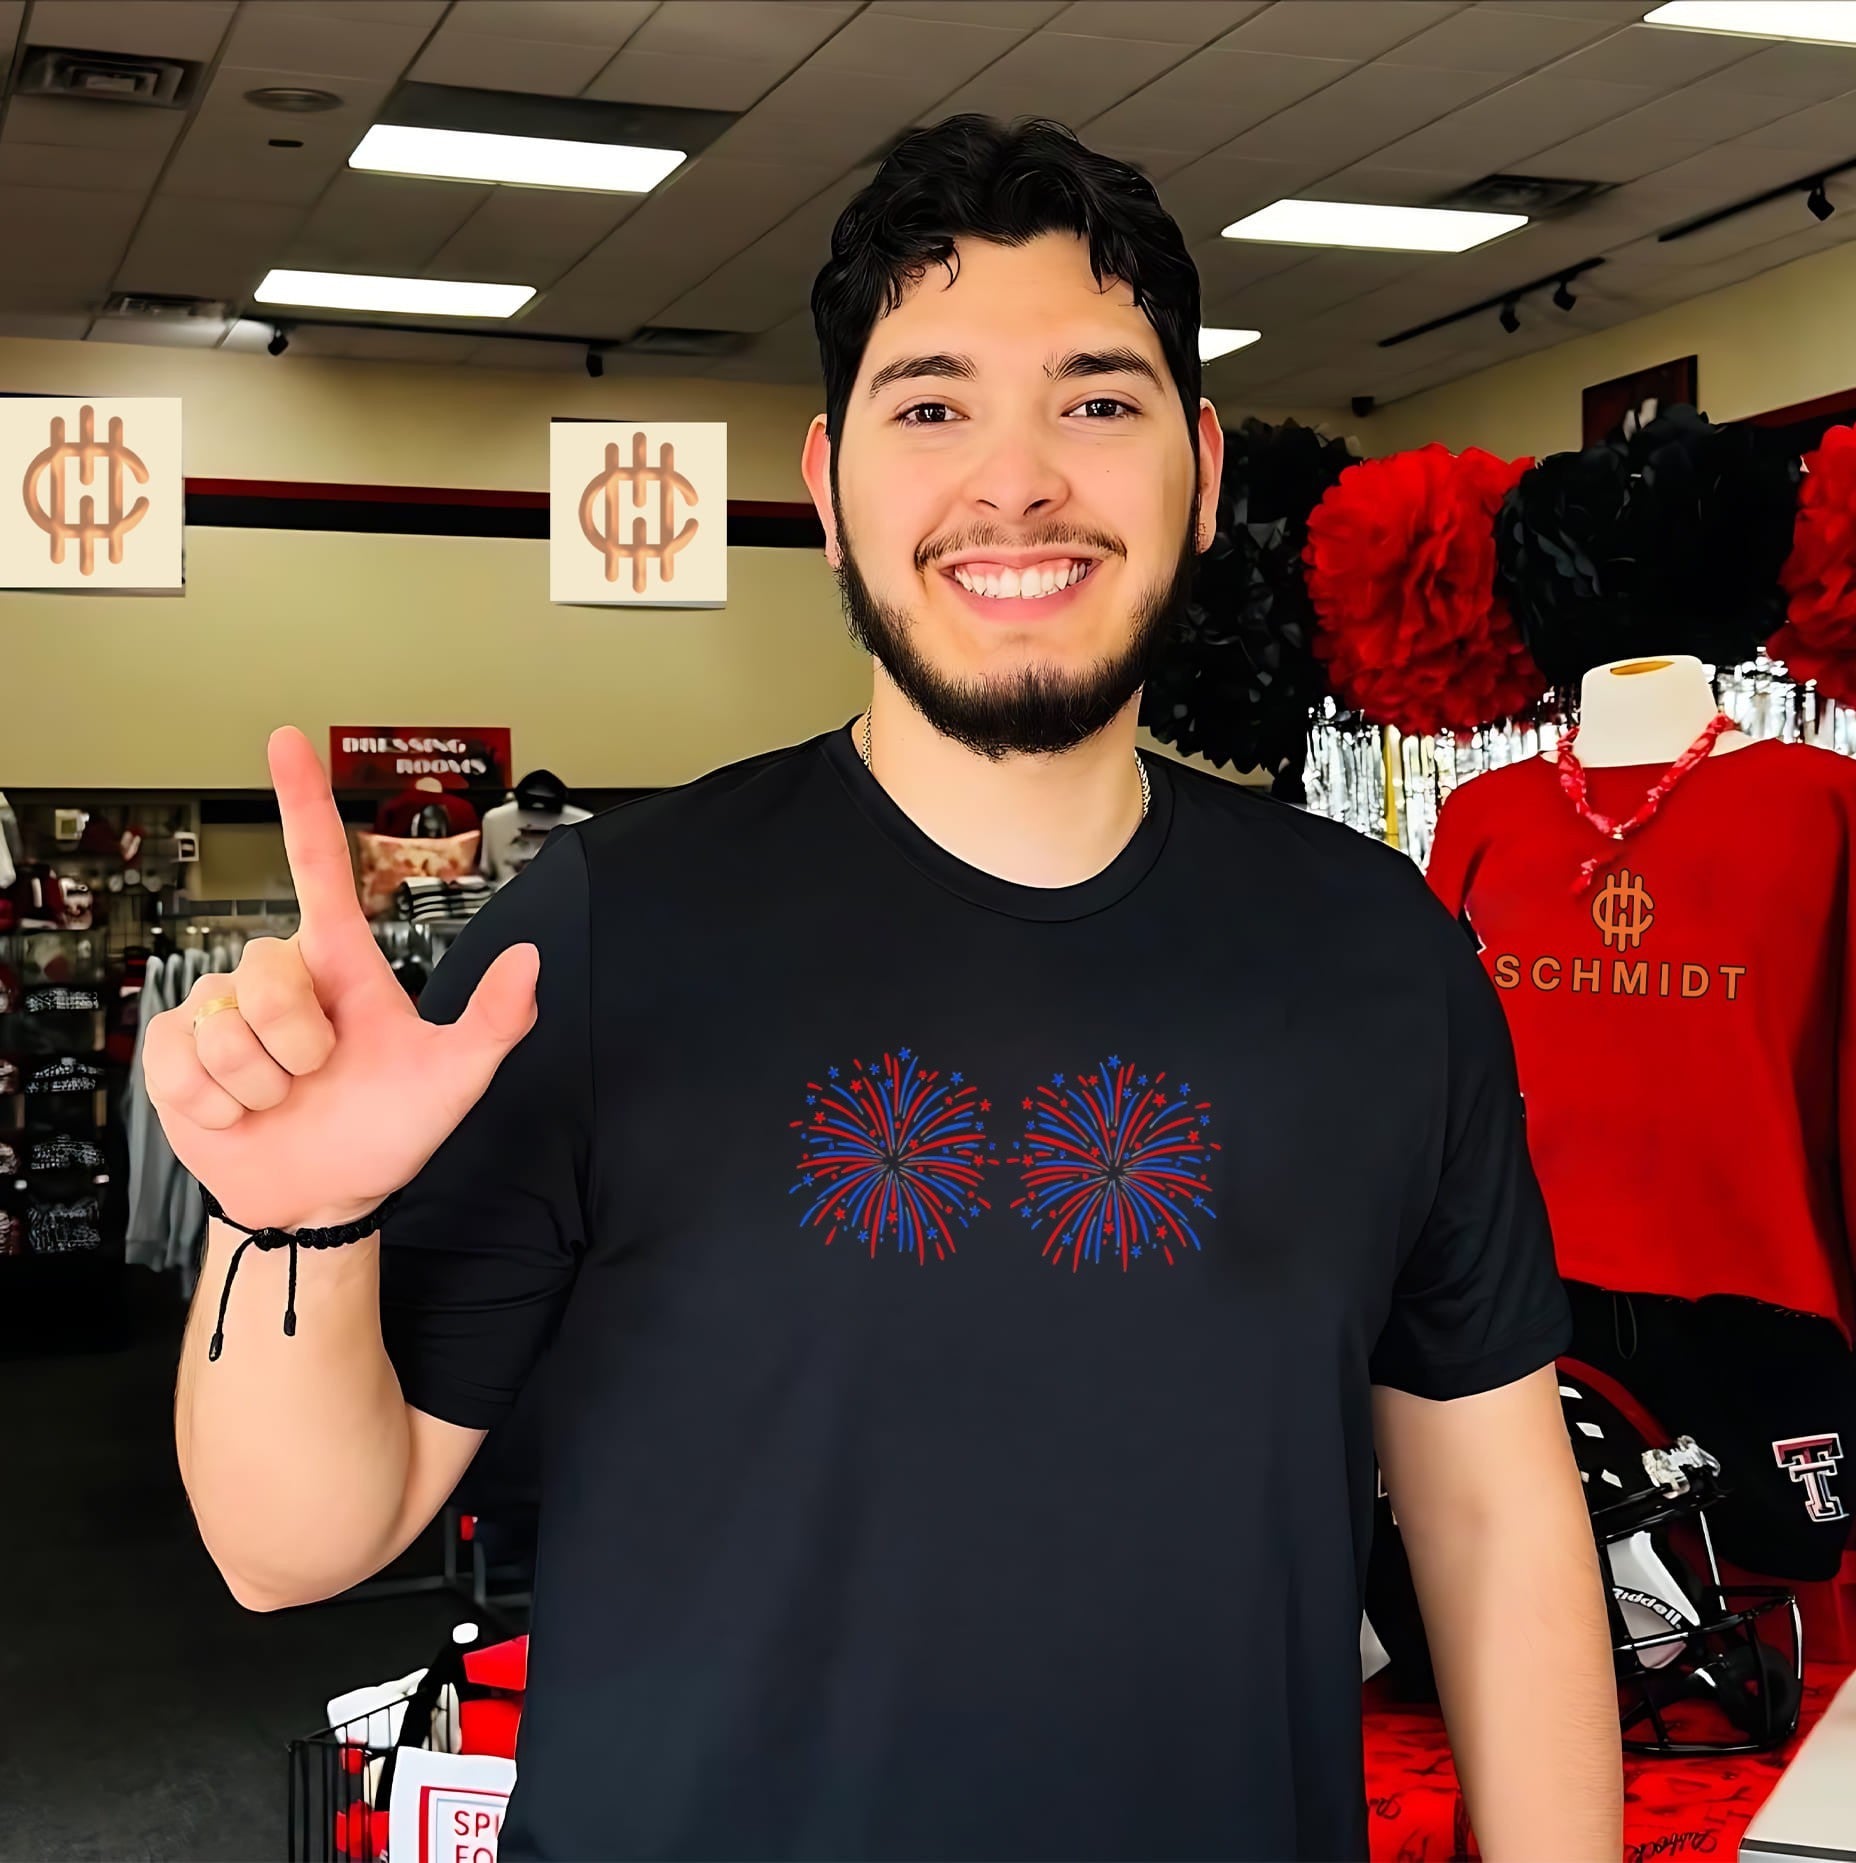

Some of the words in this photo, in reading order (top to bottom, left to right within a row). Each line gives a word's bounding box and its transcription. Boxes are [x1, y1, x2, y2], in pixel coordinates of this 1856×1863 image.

[342, 737, 466, 754] DRESSING
[396, 758, 487, 775] ROOMS
[1494, 954, 1746, 1000] SCHMIDT
